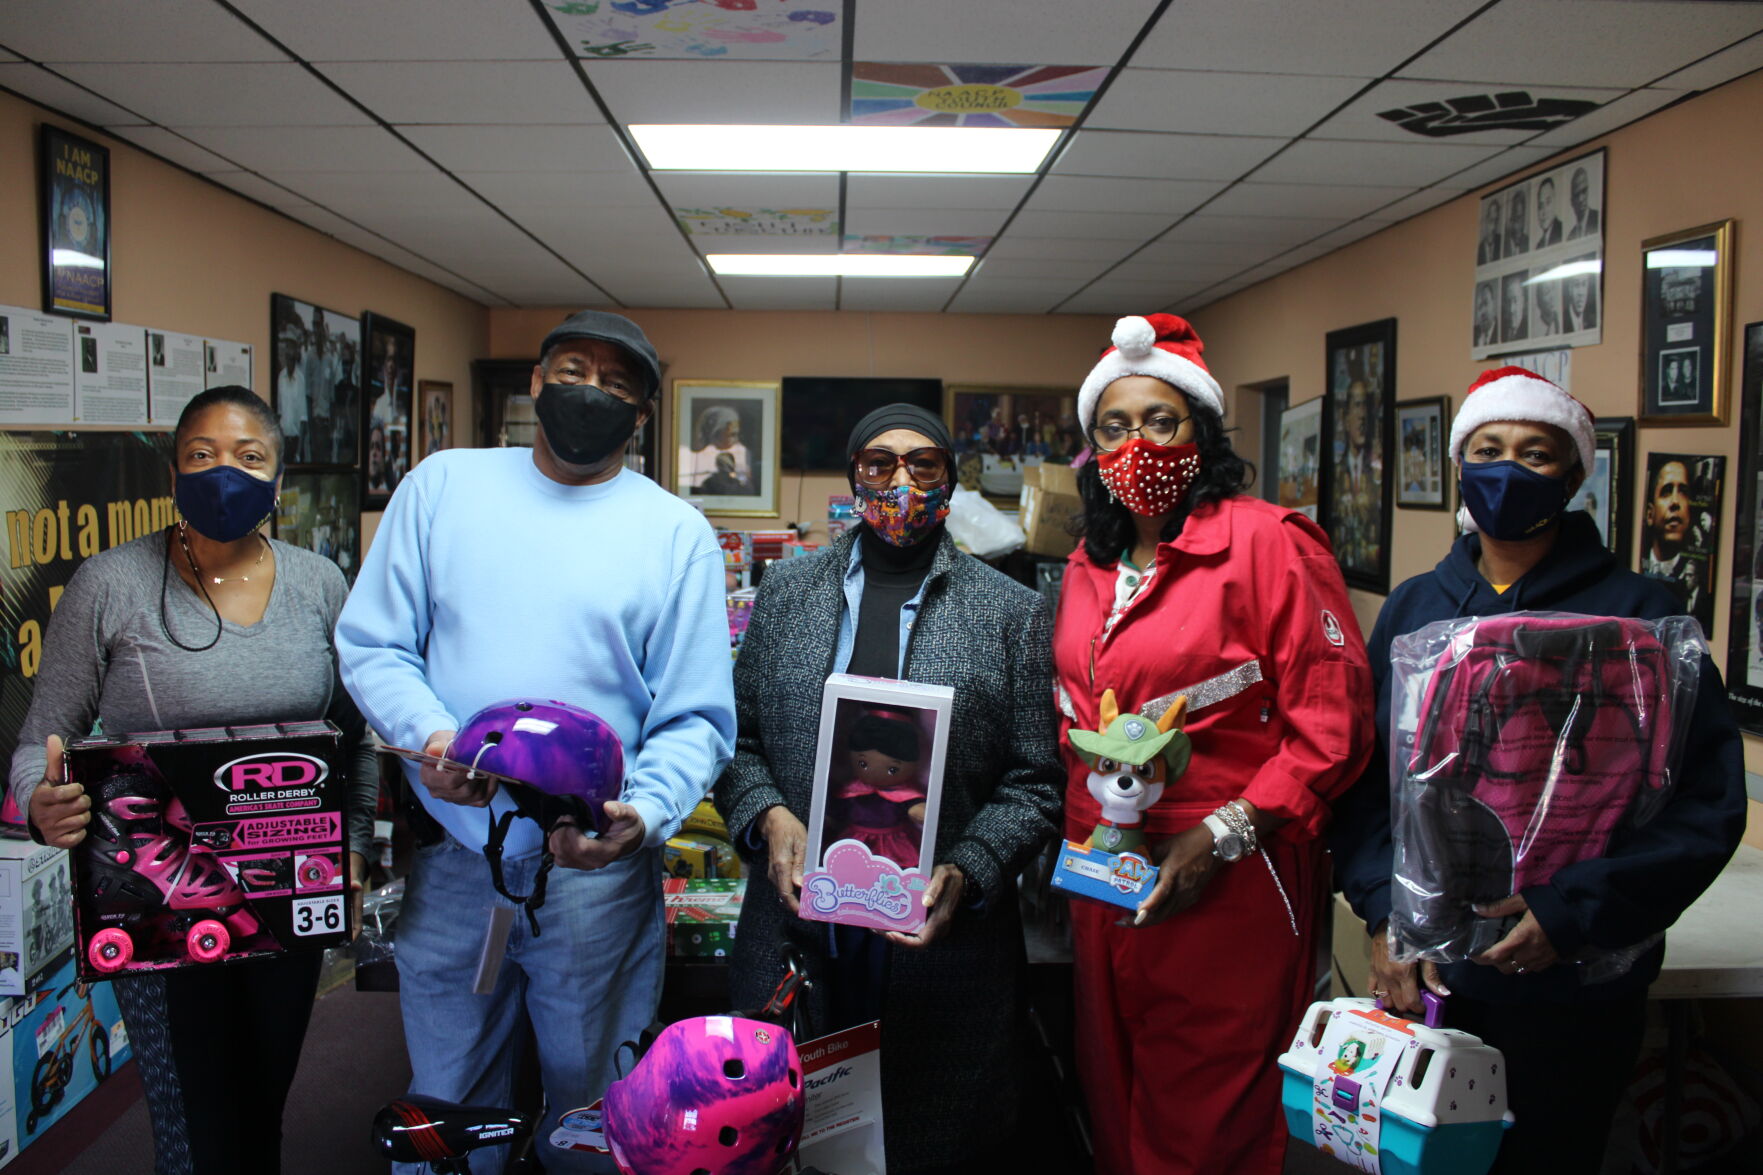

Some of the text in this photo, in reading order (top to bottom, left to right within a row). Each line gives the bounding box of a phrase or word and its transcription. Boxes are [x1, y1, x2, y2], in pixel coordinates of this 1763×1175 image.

[64, 144, 91, 167] I AM
[56, 158, 98, 186] NAACP
[6, 496, 182, 570] not a mom
[18, 619, 42, 678] a
[231, 761, 316, 790] RD
[229, 788, 316, 802] ROLLER DERBY
[229, 800, 318, 813] AMERICA'S SKATE COMPANY
[247, 816, 327, 831] ADJUSTABLE
[247, 825, 328, 839] SIZING
[261, 836, 305, 846] GROWING
[306, 833, 328, 841] FEET
[1080, 865, 1100, 874] CHASE
[1107, 856, 1154, 884] PAW
[809, 875, 902, 912] Butterflies
[1113, 877, 1138, 889] PATROL
[297, 903, 340, 933] 3-6
[799, 1039, 849, 1063] Youth Bike
[804, 1065, 853, 1090] Pacific
[478, 1128, 514, 1140] IGNITER
